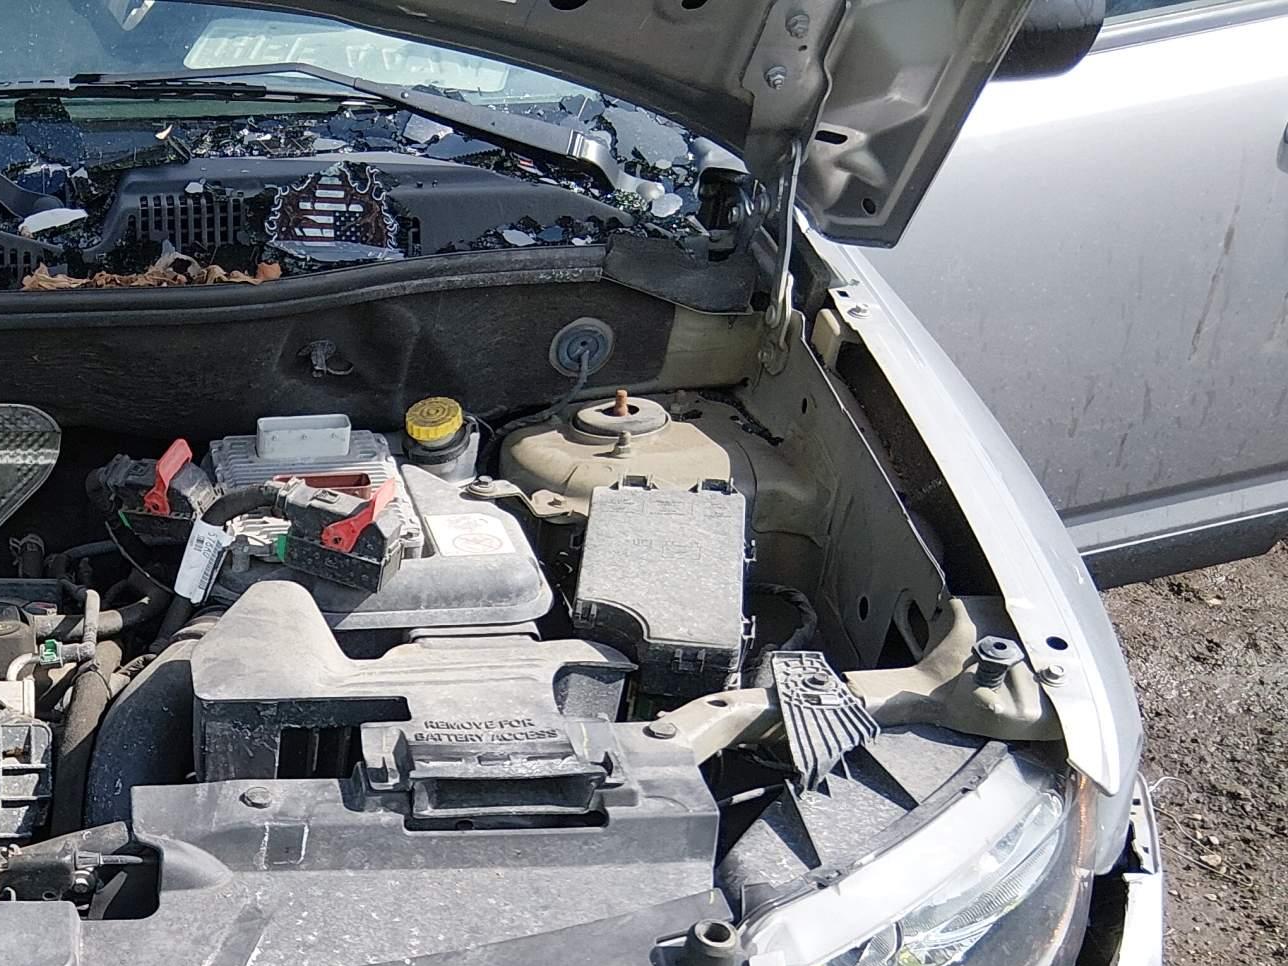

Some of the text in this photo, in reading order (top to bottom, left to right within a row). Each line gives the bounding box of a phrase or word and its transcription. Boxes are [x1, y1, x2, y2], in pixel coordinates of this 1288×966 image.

[423, 718, 535, 730] REMOVE FOR
[414, 729, 558, 742] BATTERY ACCESS
